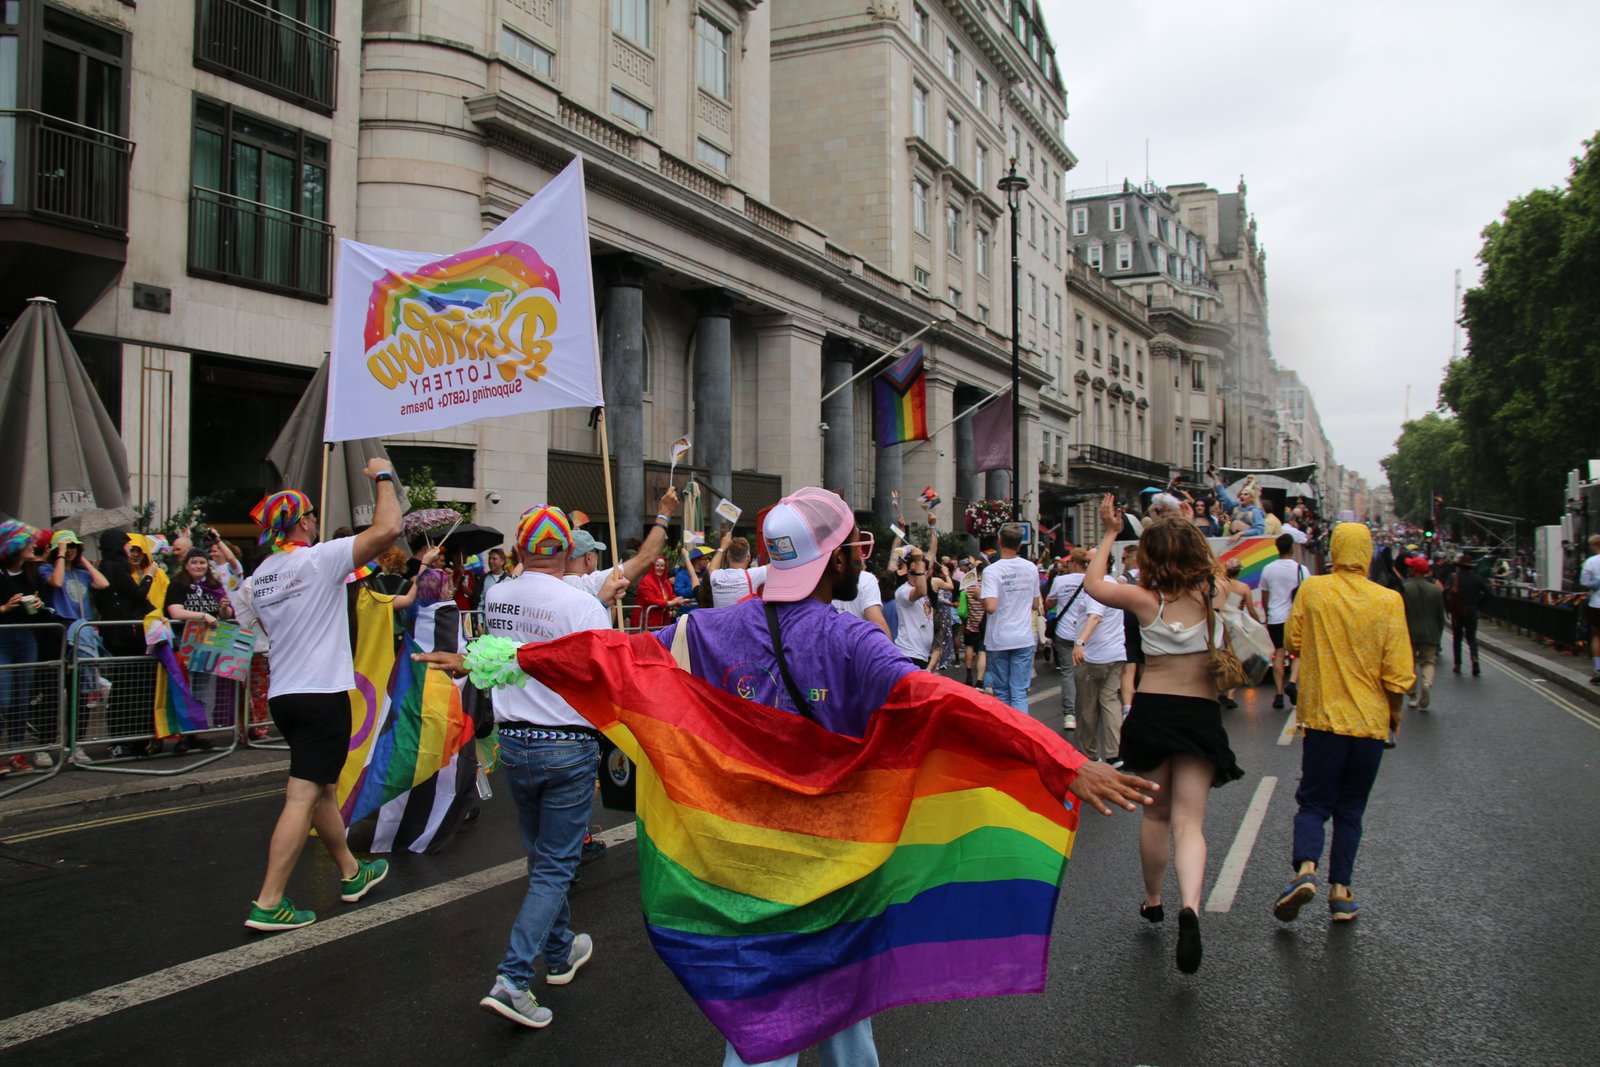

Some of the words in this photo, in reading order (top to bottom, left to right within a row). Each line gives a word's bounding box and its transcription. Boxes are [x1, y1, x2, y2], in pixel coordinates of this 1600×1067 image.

[254, 573, 279, 586] WHERE
[487, 602, 521, 616] WHERE
[522, 606, 556, 623] PRIDE
[182, 621, 236, 650] FREE
[487, 618, 513, 631] MEETS
[515, 621, 554, 638] PRIZES
[189, 648, 249, 681] HUGS
